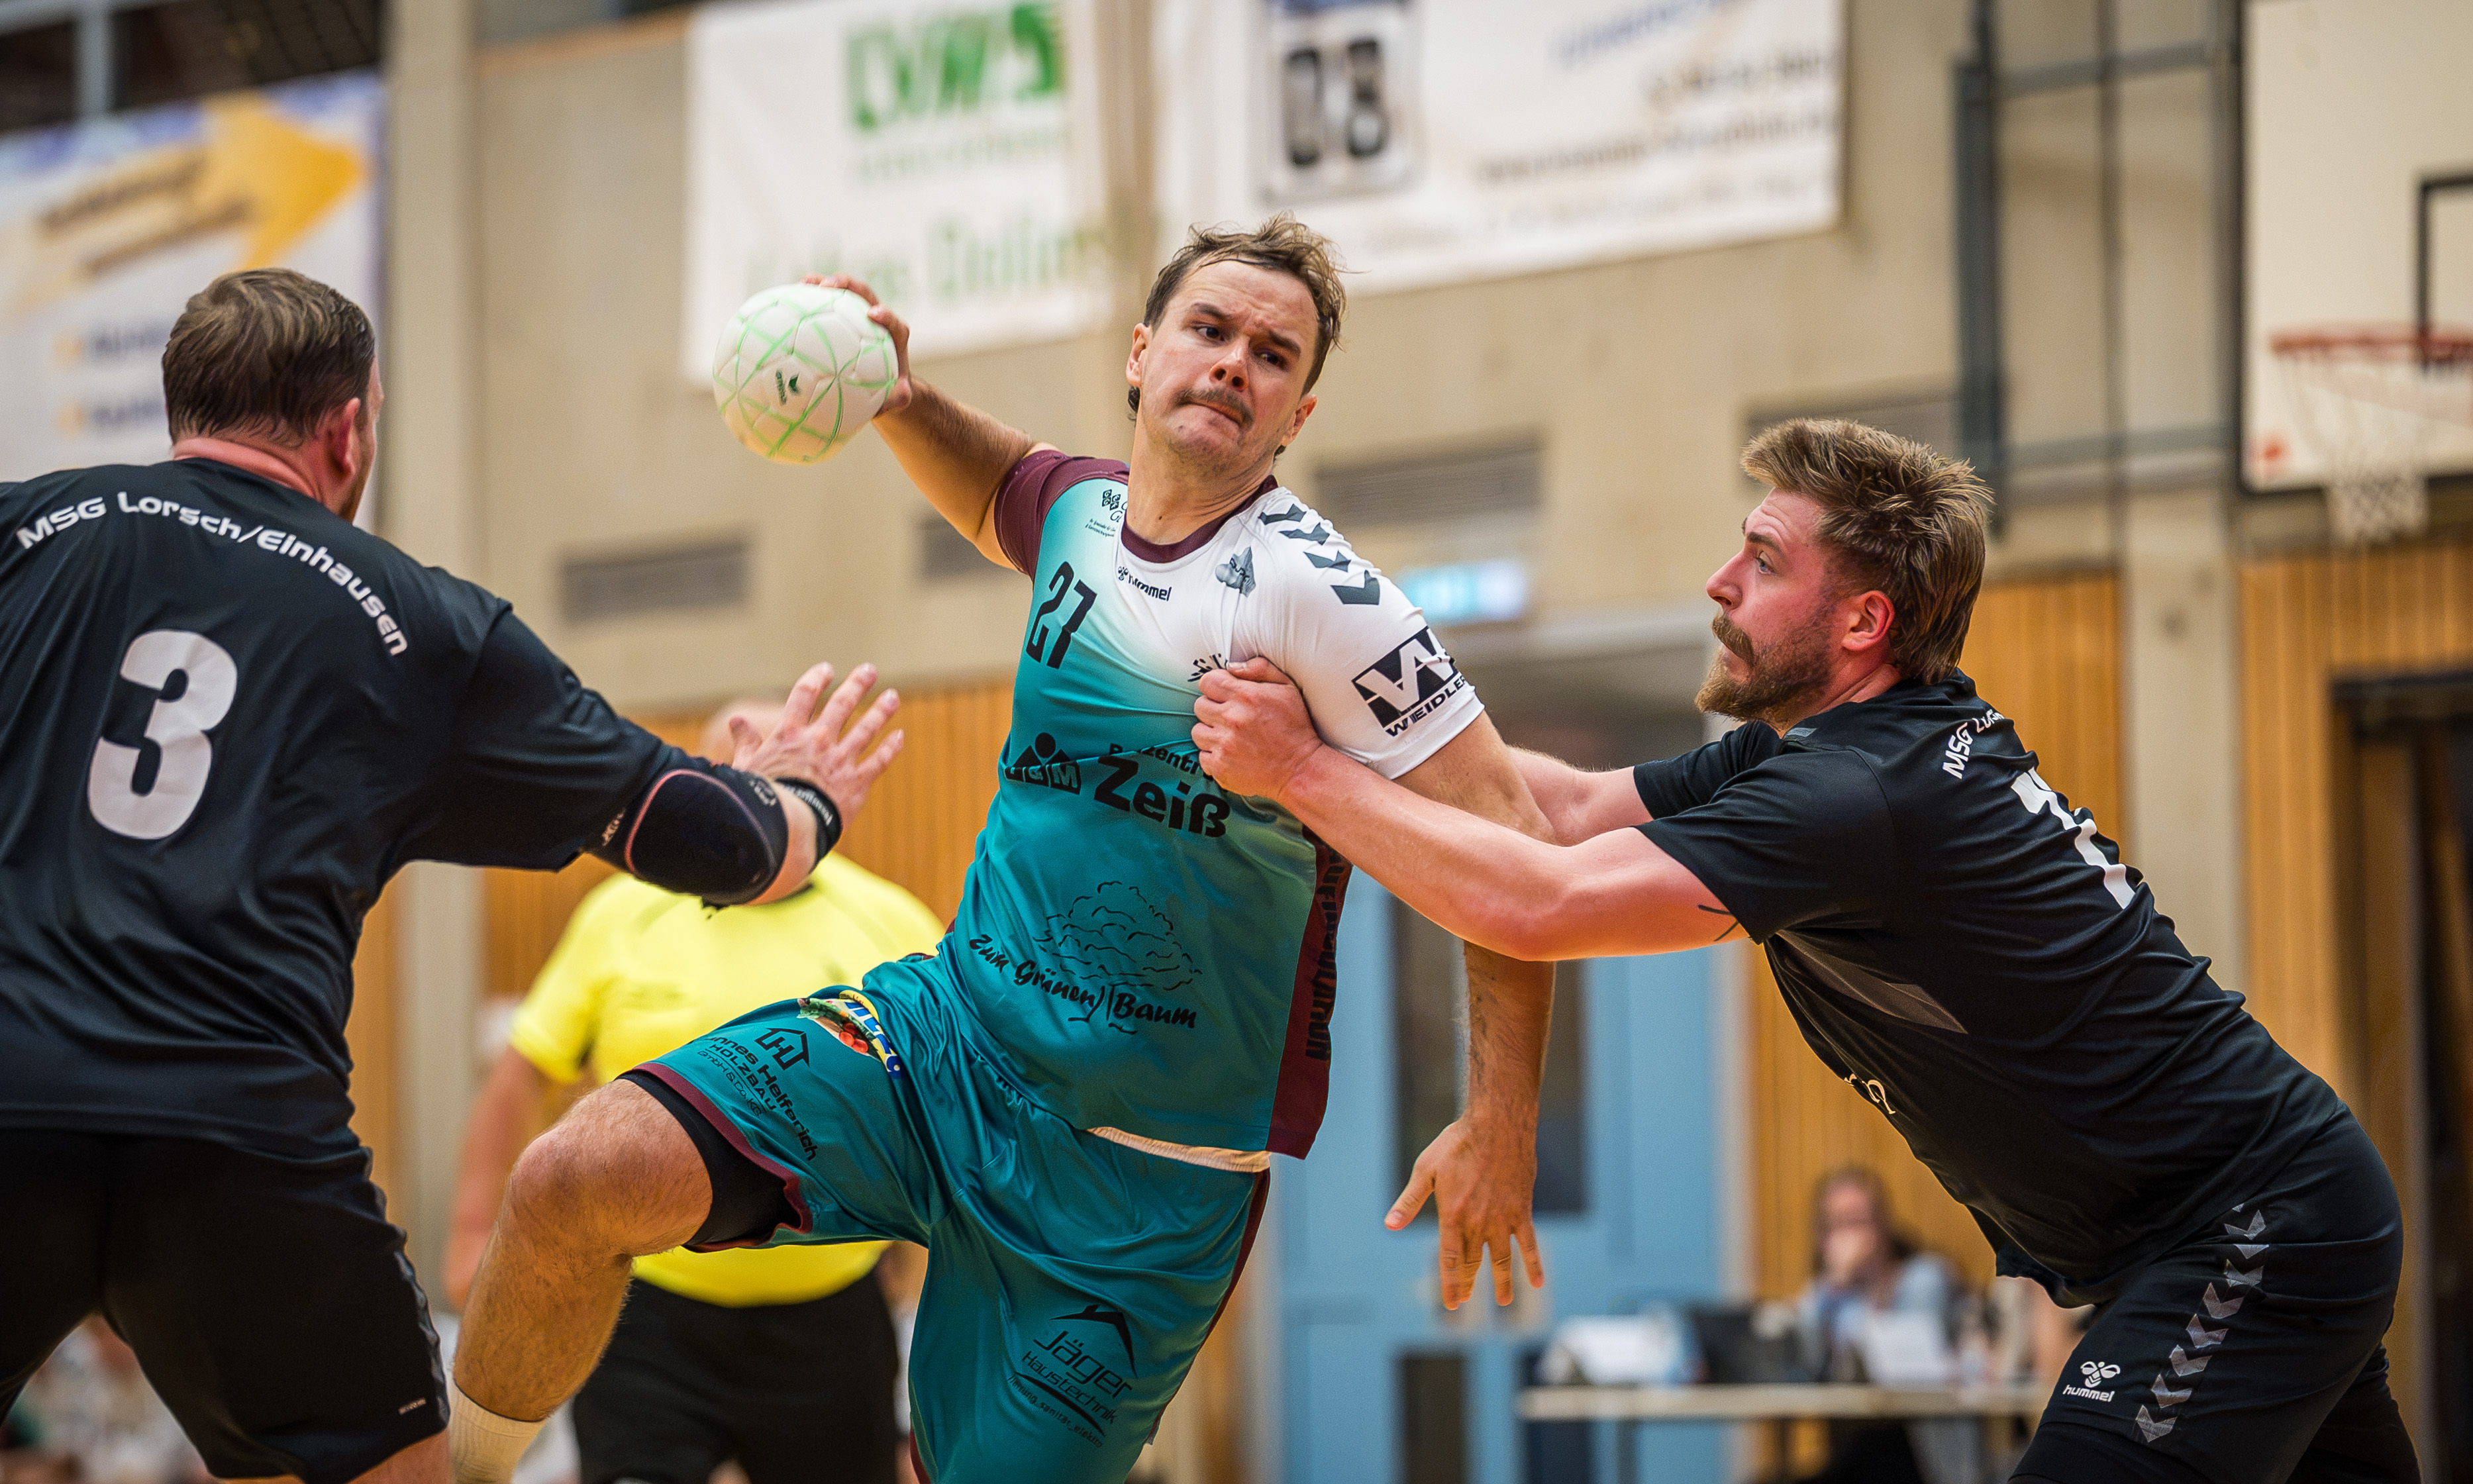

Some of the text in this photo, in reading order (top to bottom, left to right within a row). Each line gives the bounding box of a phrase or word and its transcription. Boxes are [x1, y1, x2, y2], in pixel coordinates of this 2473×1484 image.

[17, 491, 409, 656] MSG Lorsch/Einhausen
[1026, 562, 1097, 669] 27
[87, 629, 237, 839] 3
[1943, 722, 1973, 779] MSG
[1093, 756, 1230, 838] Zeiß
[969, 934, 1196, 1029] Zum Grünen Baum
[709, 1044, 776, 1111] HOLZBAU
[725, 1072, 736, 1083] &
[757, 1064, 818, 1161] Helferich
[1022, 1351, 1117, 1424] Haustechnik
[1033, 1330, 1133, 1399] Jäger
[2062, 1385, 2115, 1402] hummel
